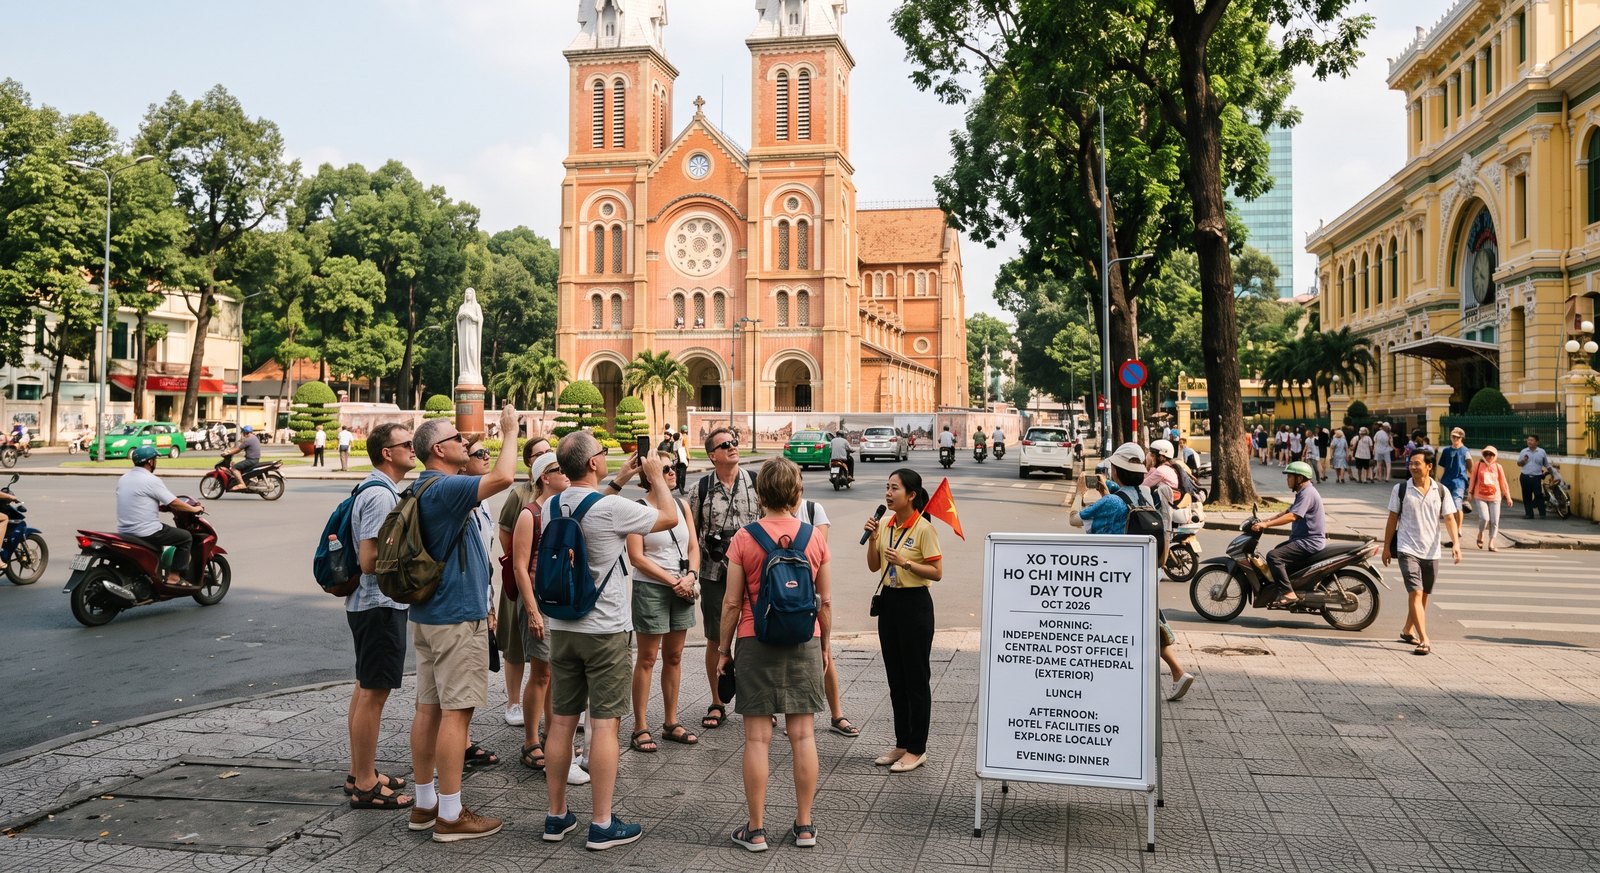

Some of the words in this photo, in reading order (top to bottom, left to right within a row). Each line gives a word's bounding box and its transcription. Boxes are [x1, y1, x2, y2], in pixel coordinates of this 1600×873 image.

[1026, 553, 1046, 565] XO
[1050, 554, 1099, 566] TOURS
[1003, 569, 1024, 580] HO
[1028, 569, 1052, 581] CHI
[1057, 570, 1095, 582] MINH
[1099, 571, 1131, 583] CITY
[1030, 585, 1059, 596] DAY
[1063, 586, 1103, 598] TOUR
[1041, 600, 1063, 609] OCT
[1065, 601, 1090, 610] 2026
[1039, 620, 1092, 629] MORNING:
[1002, 630, 1084, 642] INDEPENDENCE
[1087, 635, 1128, 644] PALACE
[1005, 643, 1052, 653] CENTRAL
[1055, 646, 1083, 655] POST
[1085, 647, 1123, 656] OFFICE
[997, 654, 1067, 667] NOTRE-DAME
[1069, 658, 1134, 670] CATHEDRAL
[1035, 668, 1094, 681] (EXTERIOR)
[1046, 688, 1082, 699] LUNCH
[1029, 707, 1098, 719] AFTERNOON:
[1008, 718, 1042, 729] HOTEL
[1045, 720, 1101, 733] FACILITIES
[1103, 725, 1120, 734] OR
[1014, 732, 1062, 743] EXPLORE
[1065, 735, 1113, 746] LOCALLY
[1016, 751, 1066, 763] EVENING:
[1068, 755, 1110, 766] DINNER
